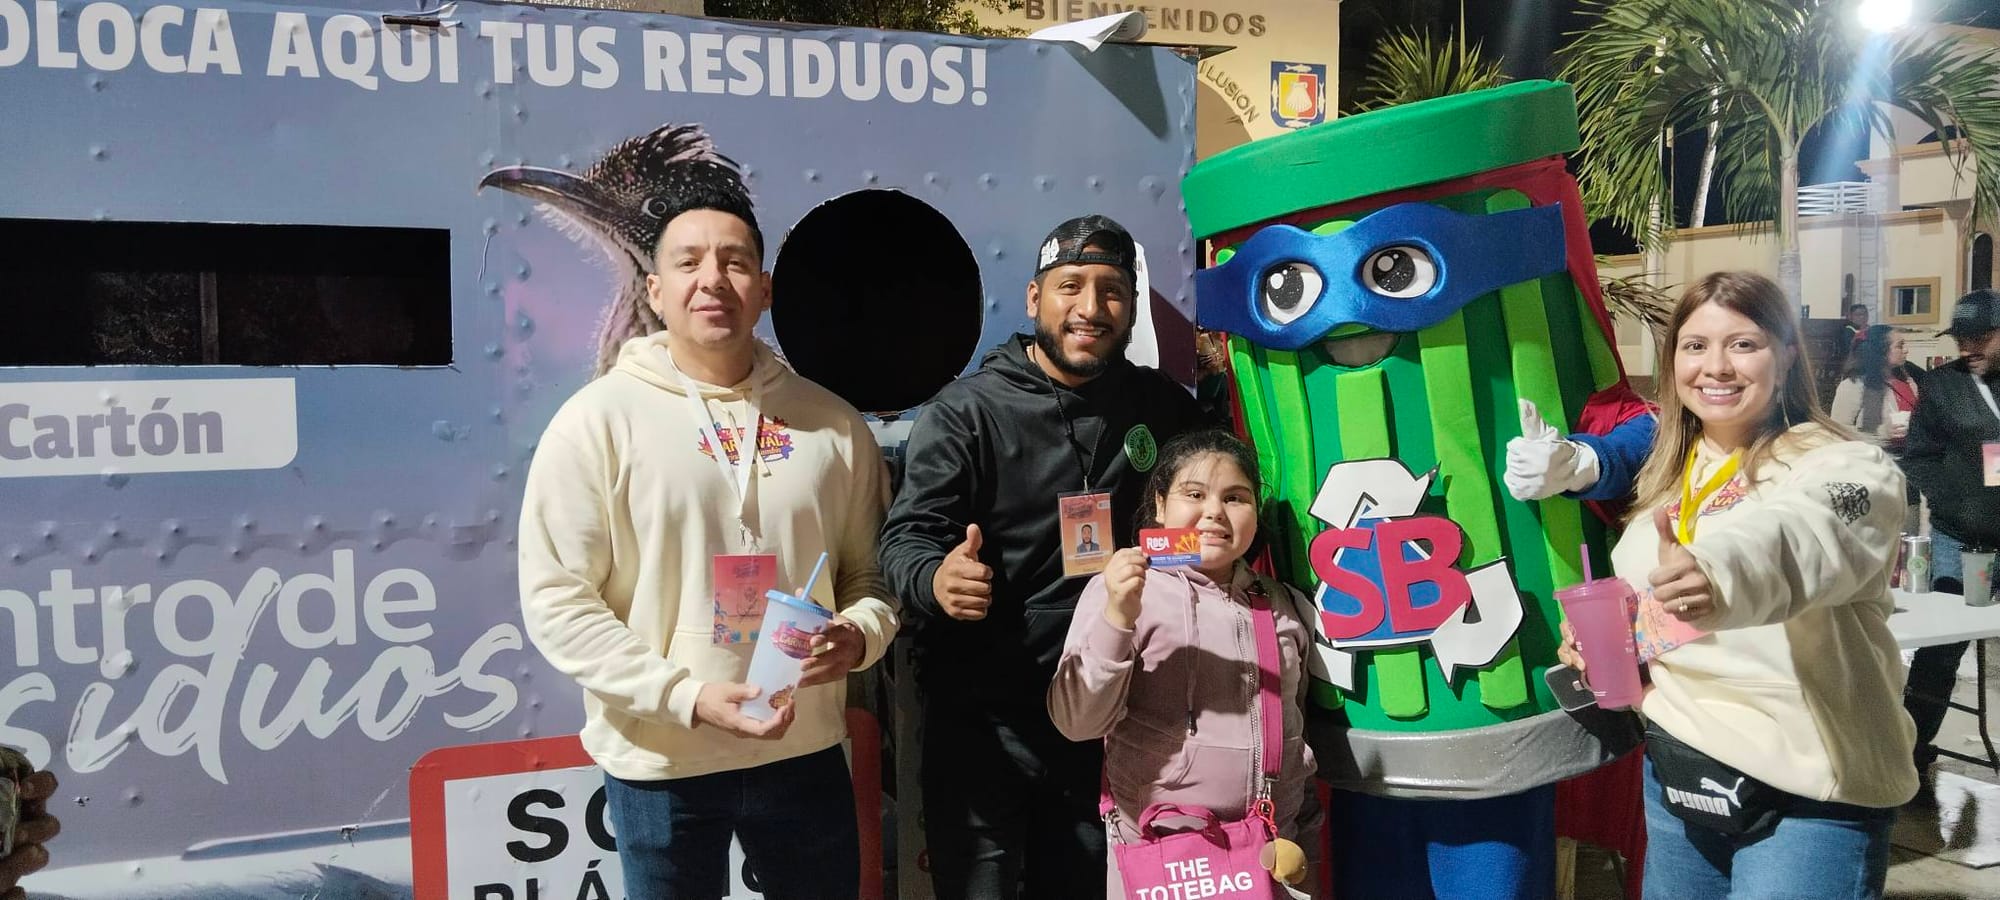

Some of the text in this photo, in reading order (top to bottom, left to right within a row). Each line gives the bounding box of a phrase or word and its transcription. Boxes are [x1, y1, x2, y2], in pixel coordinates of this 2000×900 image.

[267, 3, 459, 91] AQUÍ
[480, 20, 619, 89] TUS
[642, 29, 988, 106] RESIDUOS!
[1199, 61, 1260, 123] ILUSION
[0, 397, 224, 461] Cartón
[277, 548, 437, 648] de
[1309, 516, 1472, 639] SB
[1666, 783, 1731, 817] PUMA
[1164, 857, 1211, 882] THE
